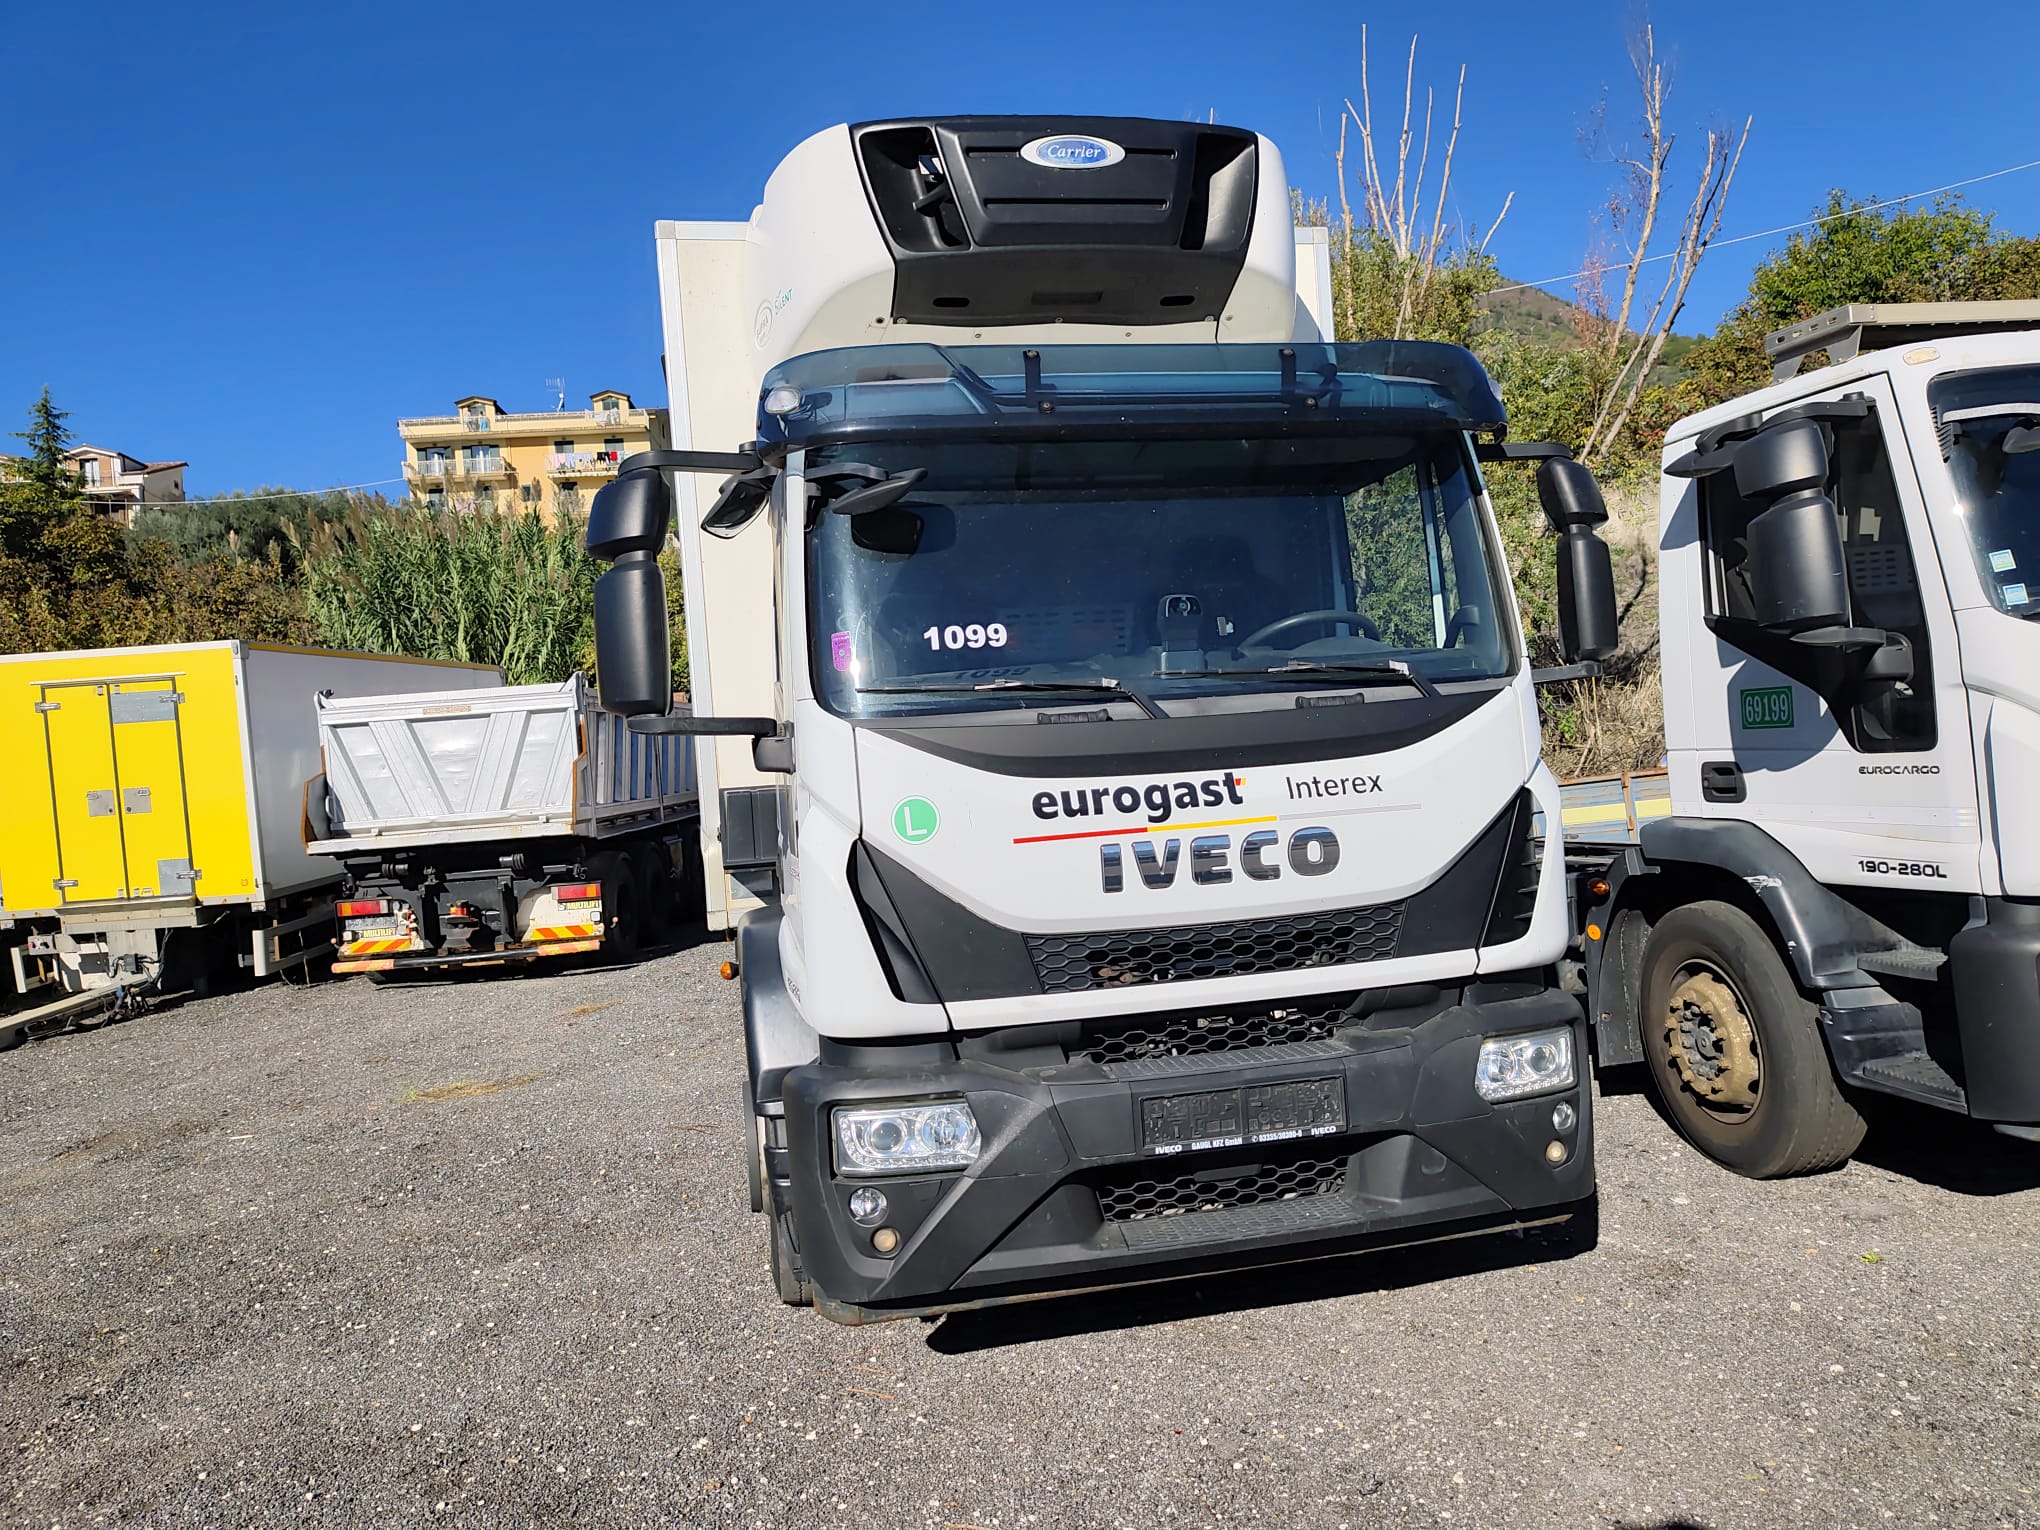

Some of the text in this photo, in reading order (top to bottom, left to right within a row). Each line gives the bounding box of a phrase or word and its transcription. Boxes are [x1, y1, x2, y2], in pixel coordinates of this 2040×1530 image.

[1047, 145, 1101, 158] Carrier
[923, 623, 1008, 651] 1099
[1744, 693, 1790, 723] 69199
[1858, 765, 1940, 775] EUROCARGO
[1032, 772, 1384, 823] eurogast Interex
[903, 806, 928, 836] L
[1100, 826, 1341, 894] IVECO
[1858, 860, 1947, 879] 190-280L
[1155, 1144, 1182, 1155] IVECO
[1311, 1125, 1337, 1136] IVECO
